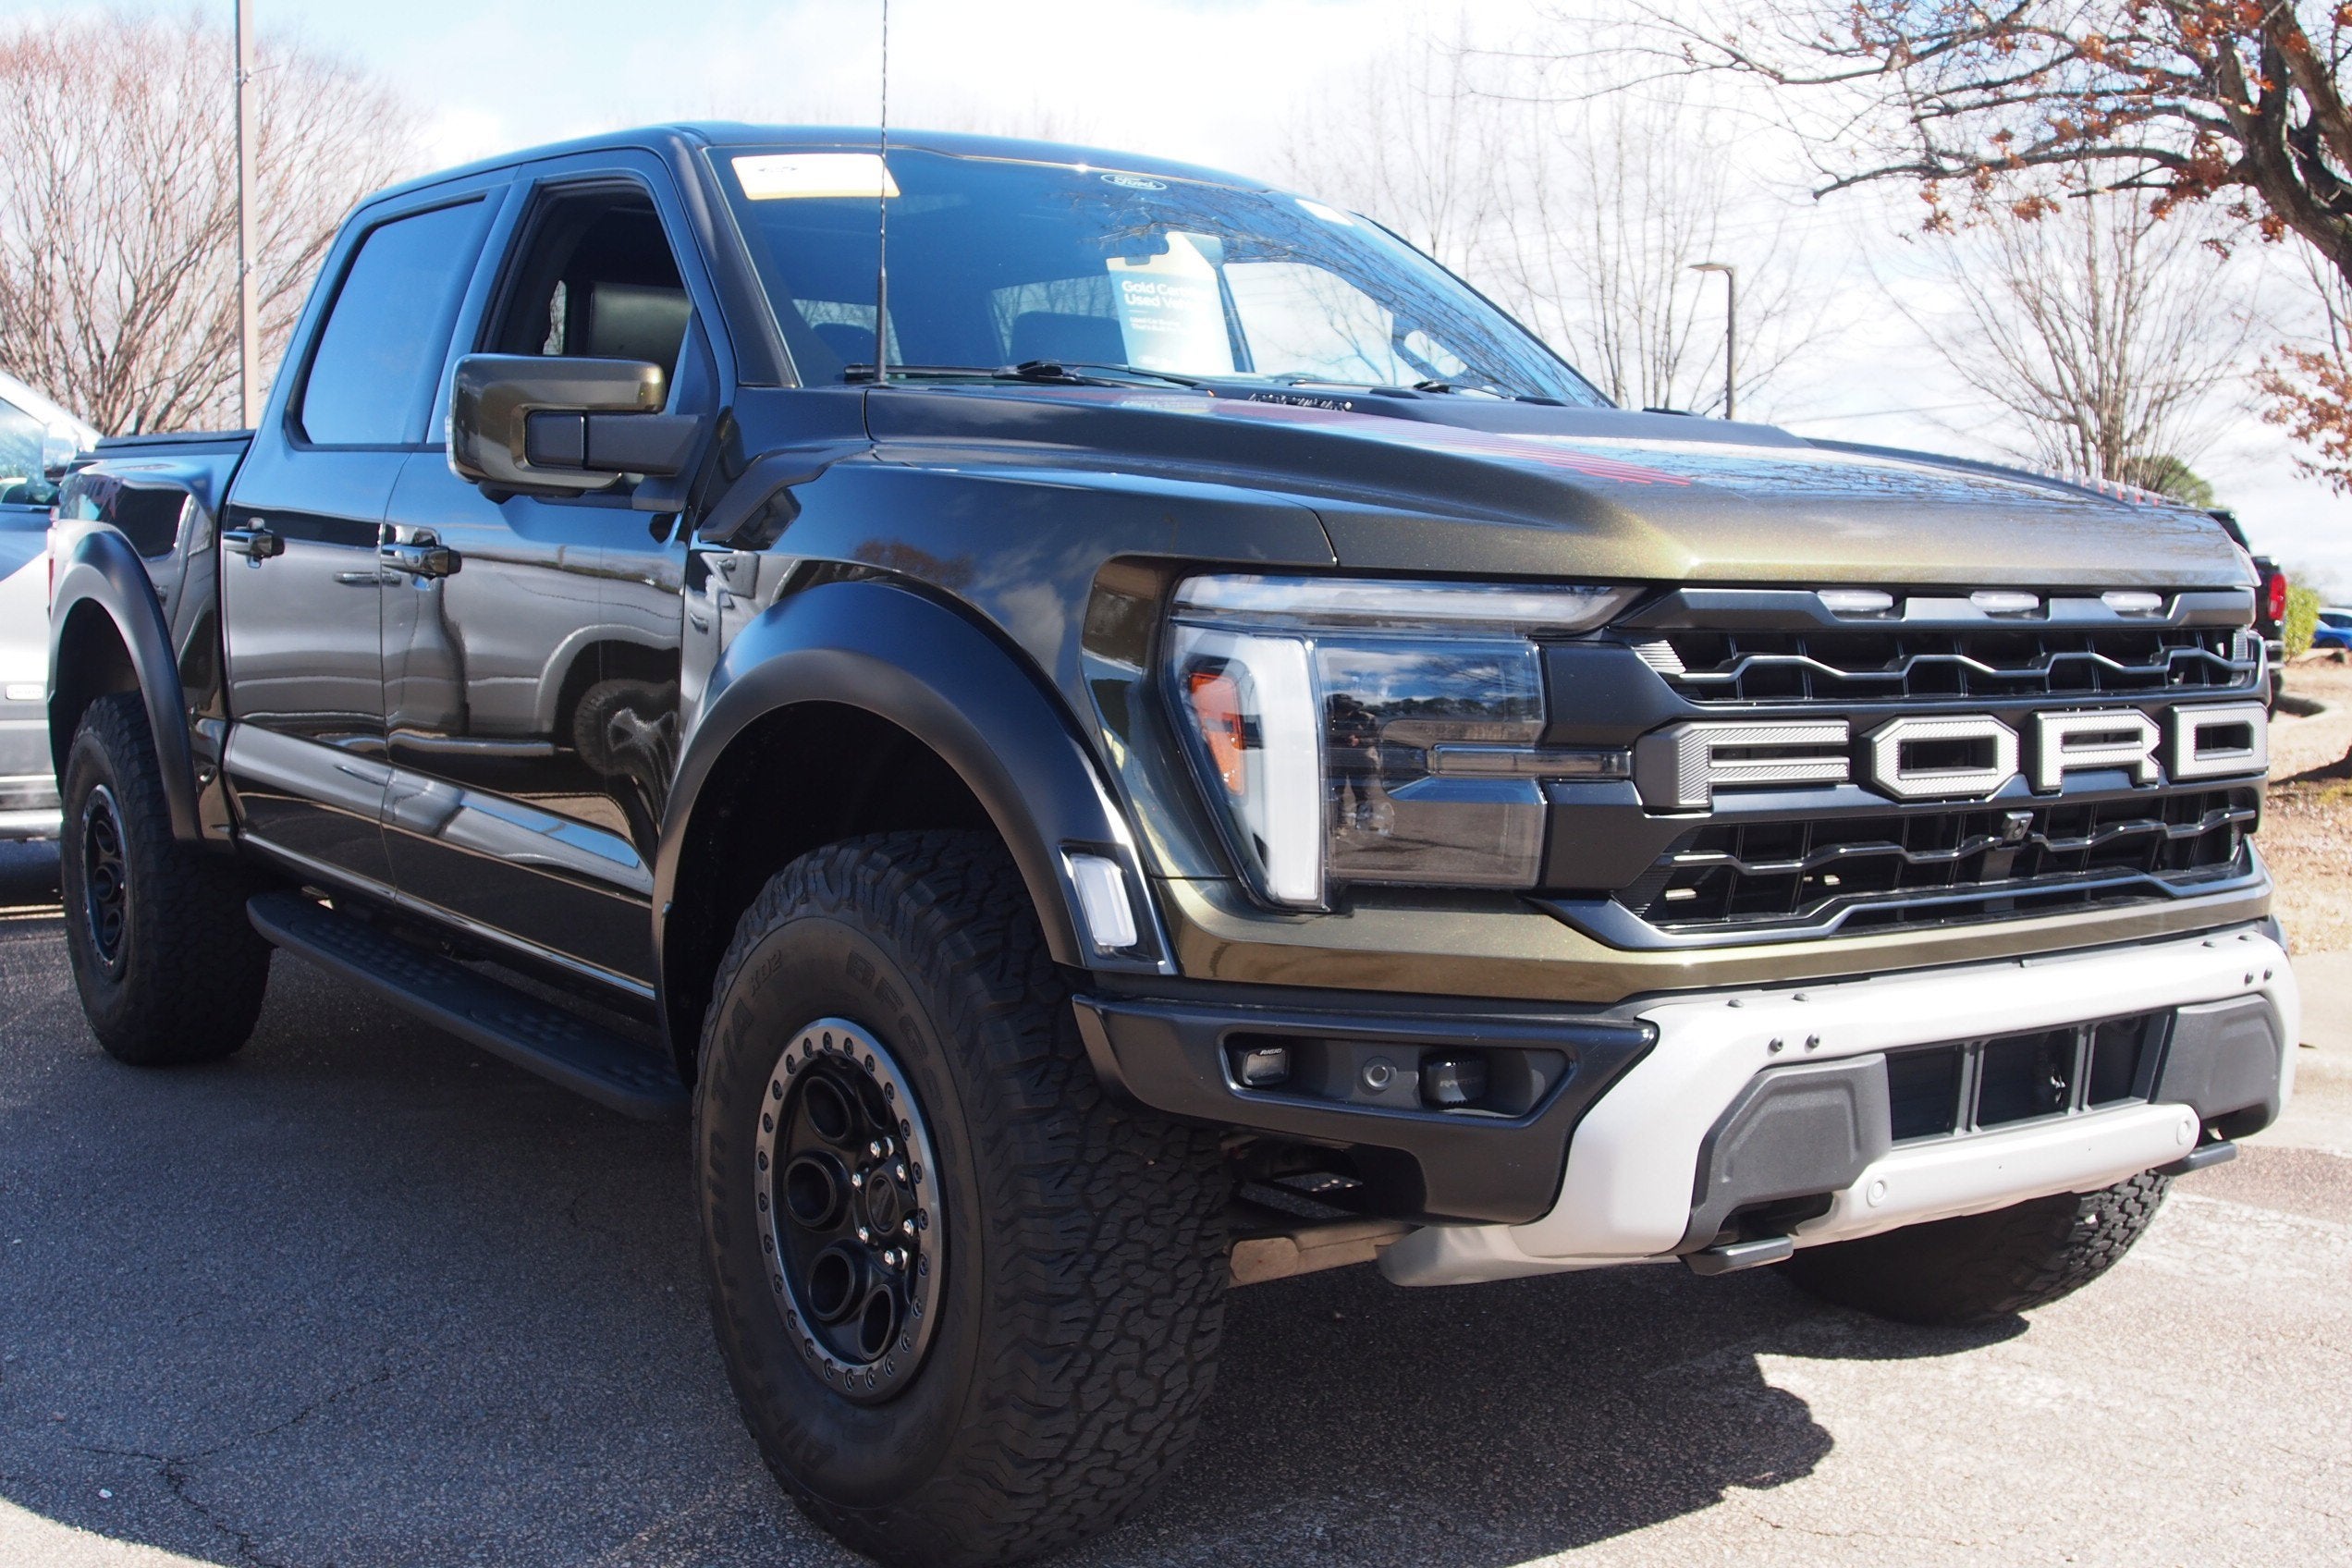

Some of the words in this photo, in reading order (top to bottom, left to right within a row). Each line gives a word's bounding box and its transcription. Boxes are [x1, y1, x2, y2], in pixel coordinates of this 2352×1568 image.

[1121, 280, 1156, 294] Gold
[1124, 293, 1161, 309] Used
[1677, 700, 2269, 808] FORD
[1259, 1047, 1283, 1056] RIGID
